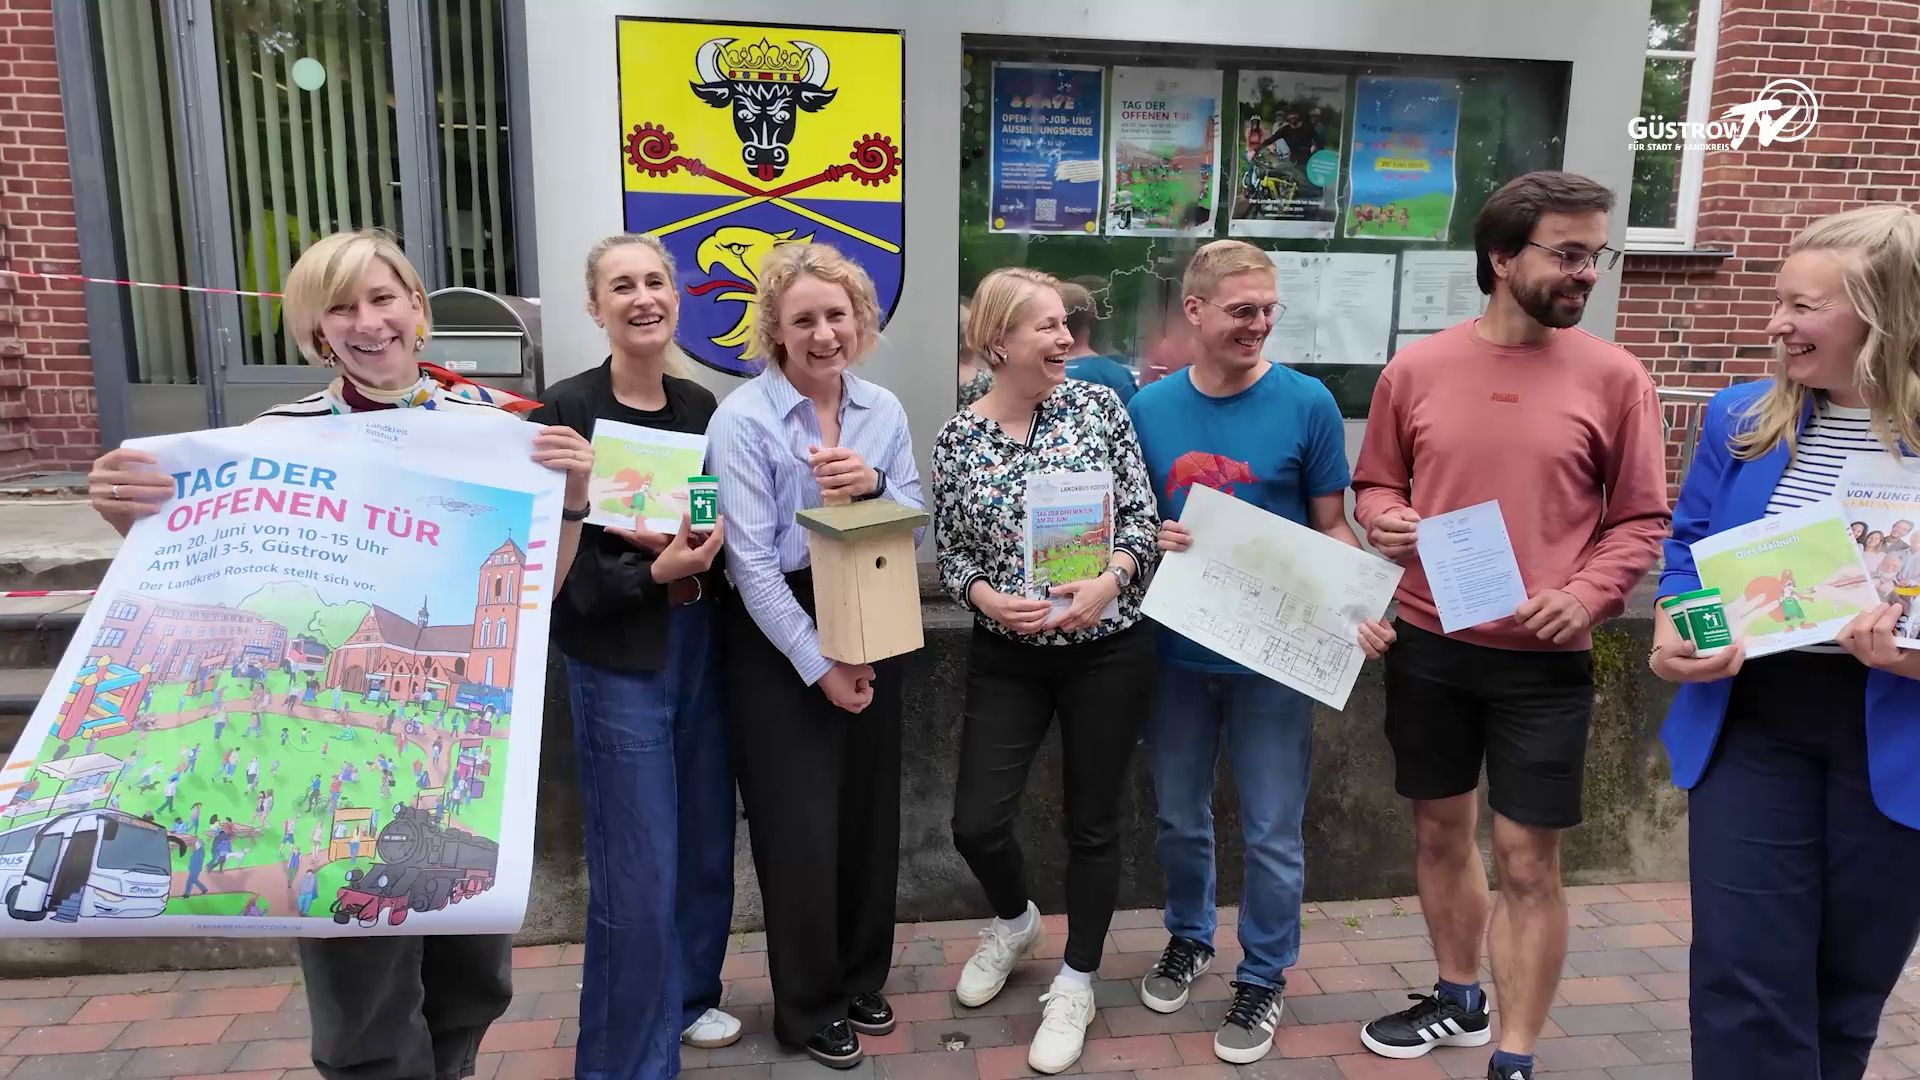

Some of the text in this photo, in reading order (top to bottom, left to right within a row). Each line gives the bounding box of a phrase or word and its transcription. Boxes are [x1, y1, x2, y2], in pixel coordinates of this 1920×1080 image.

[1121, 101, 1167, 110] TAG DER
[1072, 116, 1092, 125] UND
[1121, 111, 1170, 121] OFFENEN
[1002, 125, 1093, 136] AUSBILUNGSMESSE
[365, 428, 399, 442] Rostock
[366, 422, 409, 436] Landkreis
[171, 456, 338, 500] TAG DER
[1847, 490, 1873, 498] VON
[1875, 491, 1911, 501] JUNG
[167, 487, 441, 547] OFFENEN TÜR
[154, 542, 182, 556] am
[187, 534, 207, 550] 20.
[212, 523, 247, 542] Juni
[253, 524, 290, 537] von
[356, 536, 389, 556] Uhr
[146, 539, 348, 572] Am Wall 3-5, Güstrow
[138, 563, 377, 592] Der Landkreis Rostock stellt sich vor.
